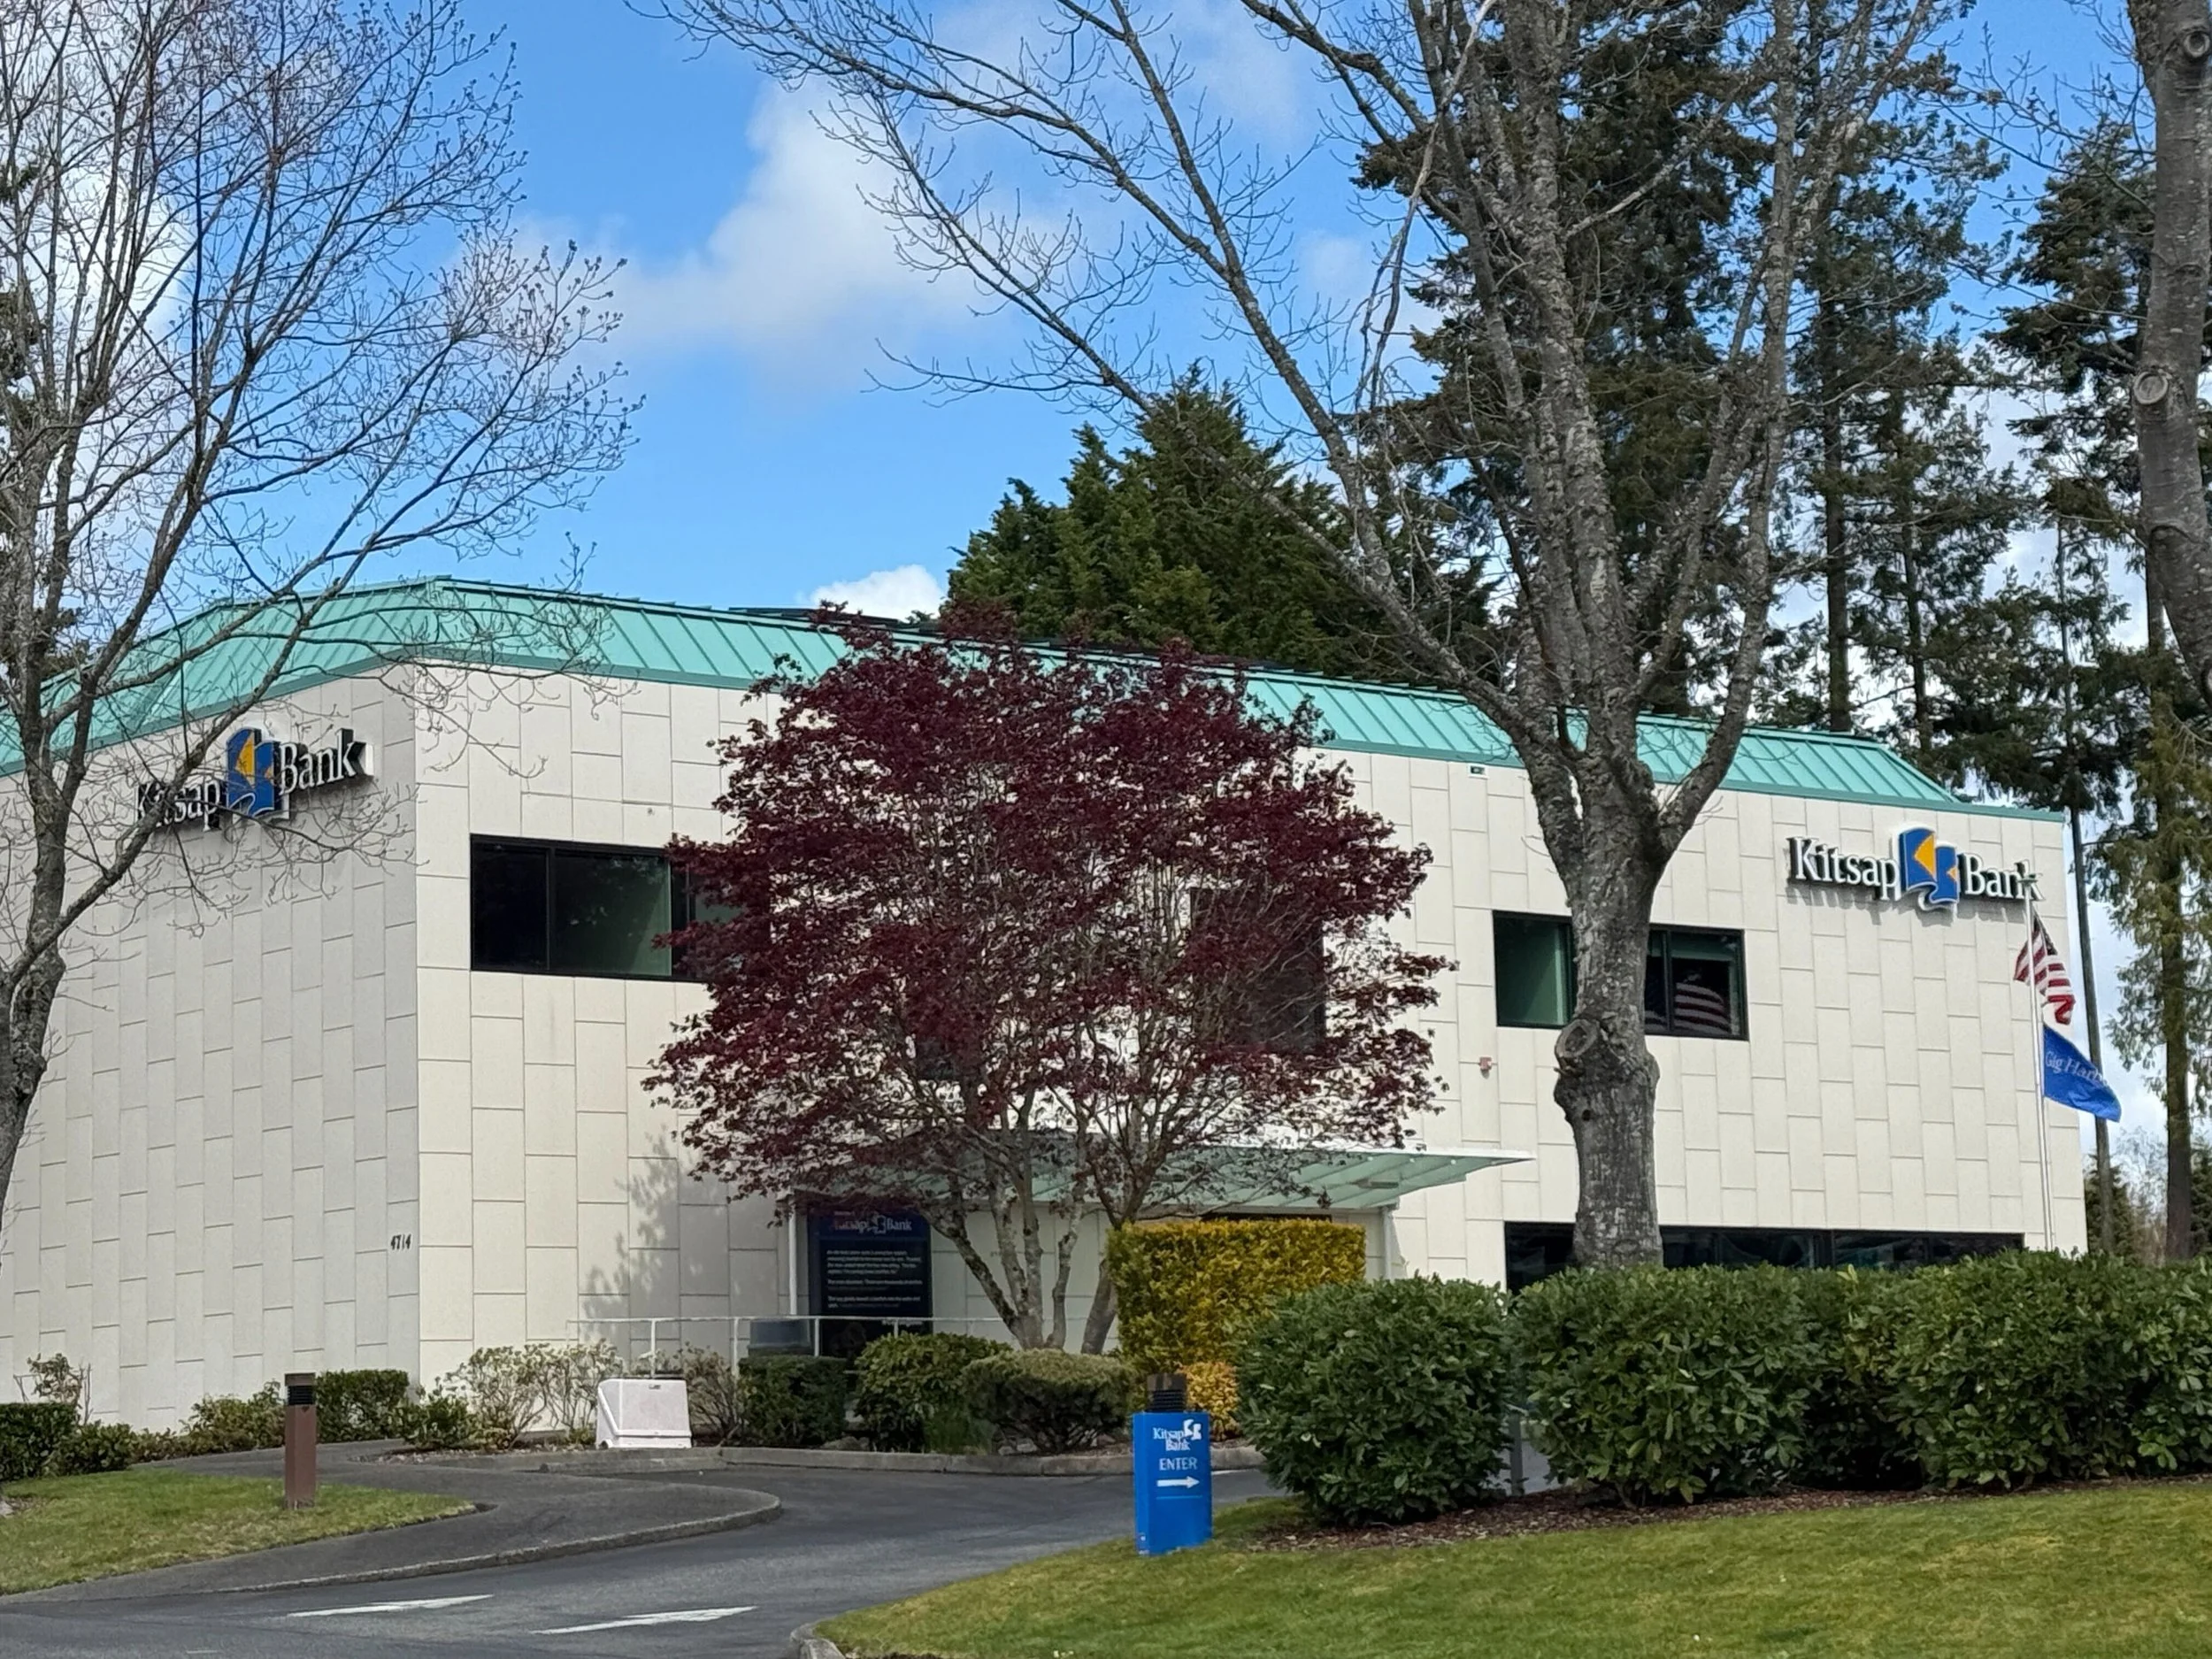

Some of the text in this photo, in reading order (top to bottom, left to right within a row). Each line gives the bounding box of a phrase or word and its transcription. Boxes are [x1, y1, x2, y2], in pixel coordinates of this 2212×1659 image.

[134, 727, 358, 833] Ksap Bank
[1792, 836, 2045, 901] Kitsap Bank
[2045, 1050, 2062, 1074] Gig
[887, 1217, 912, 1231] Bank
[390, 1233, 411, 1250] 4714
[1153, 1427, 1184, 1443] Kitsap
[1165, 1439, 1190, 1451] Bank
[1159, 1457, 1197, 1471] ENTER
